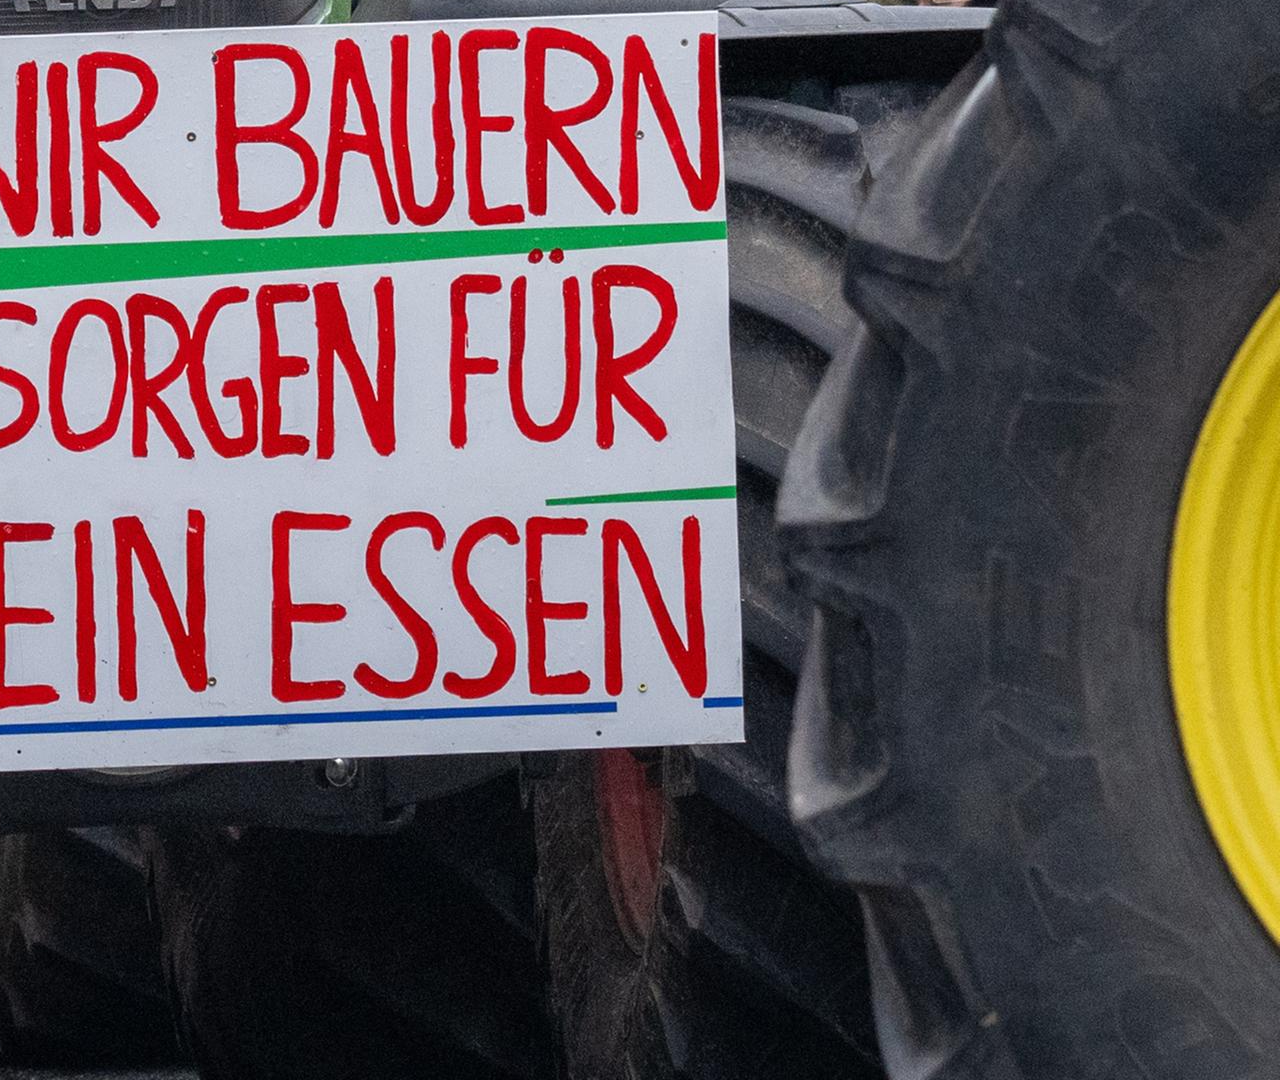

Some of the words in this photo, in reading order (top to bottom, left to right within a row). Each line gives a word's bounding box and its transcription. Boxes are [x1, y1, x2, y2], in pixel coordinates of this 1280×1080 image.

[213, 26, 720, 230] BAUERN
[449, 247, 679, 450] FÜR
[272, 510, 709, 703] ESSEN
